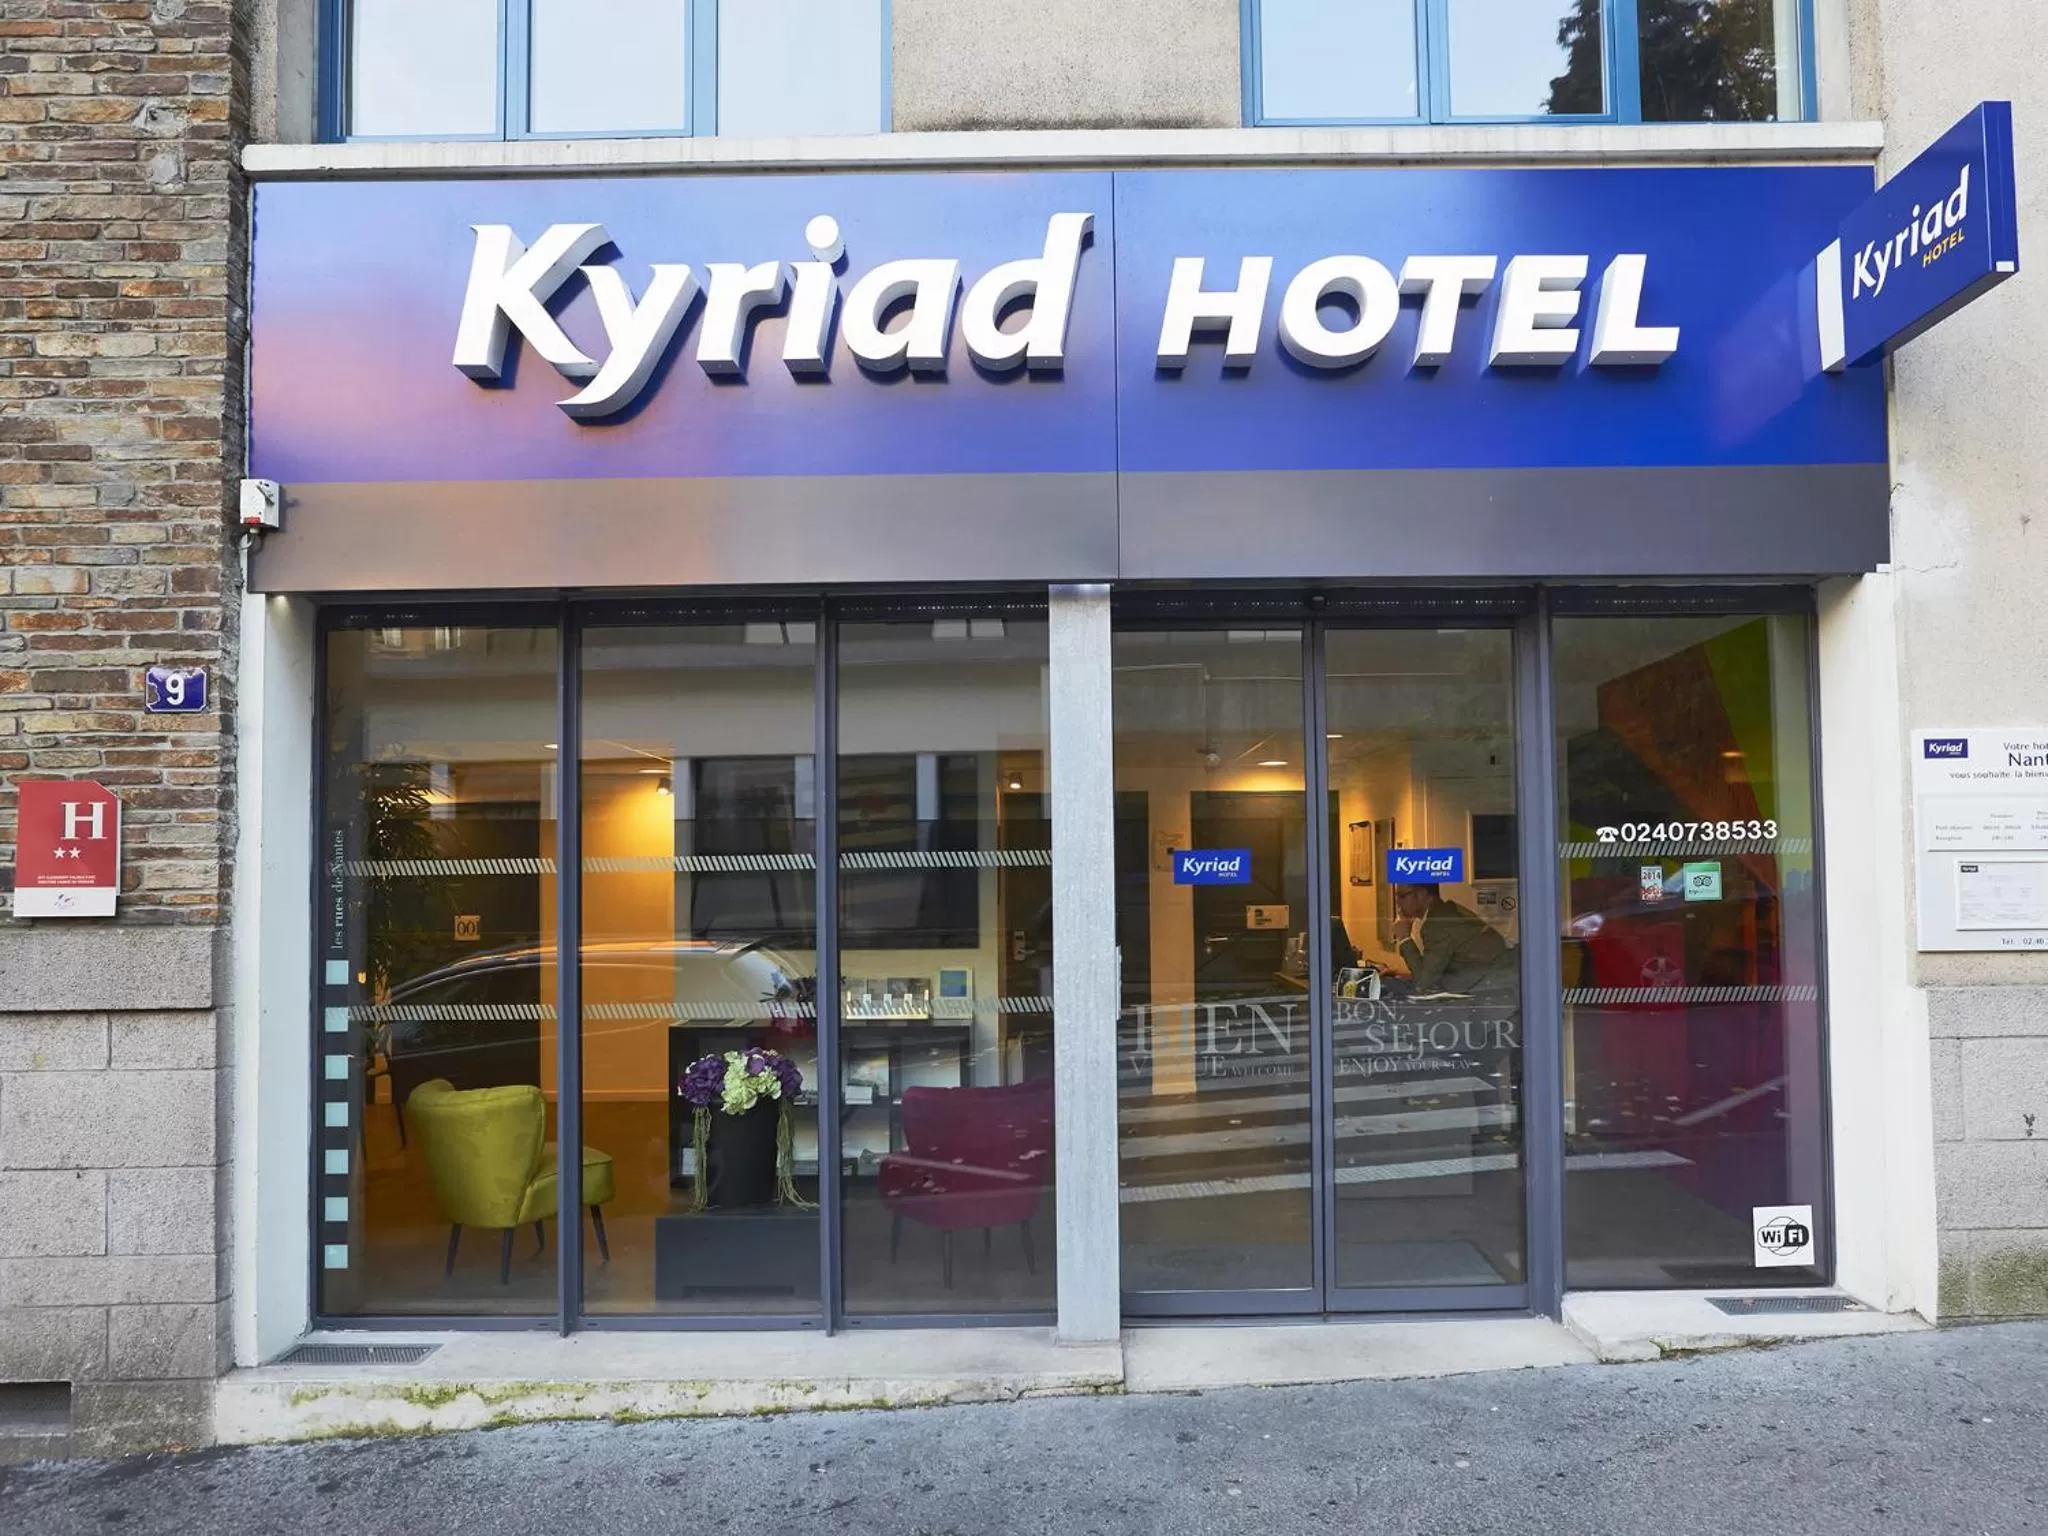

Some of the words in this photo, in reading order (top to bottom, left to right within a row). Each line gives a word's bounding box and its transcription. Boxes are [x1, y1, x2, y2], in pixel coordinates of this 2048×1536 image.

[1853, 163, 1970, 300] Kyriad
[1922, 228, 1965, 268] HOTEL
[453, 213, 1095, 418] Kyriad
[1156, 254, 1680, 368] HOTEL
[165, 672, 185, 706] 9
[1928, 742, 1963, 754] Kyriad
[2003, 742, 2030, 751] Votre
[60, 801, 108, 840] H
[1621, 820, 1778, 841] 0240738533
[330, 830, 343, 875] Nantes
[1183, 856, 1241, 876] Kyriad
[1395, 856, 1454, 875] Kyriad
[330, 876, 343, 893] de
[333, 896, 343, 928] rues
[330, 931, 343, 949] les
[1336, 1000, 1397, 1023] BON
[1366, 1015, 1521, 1061] SÉJOUR
[1340, 1056, 1400, 1077] ENJOY
